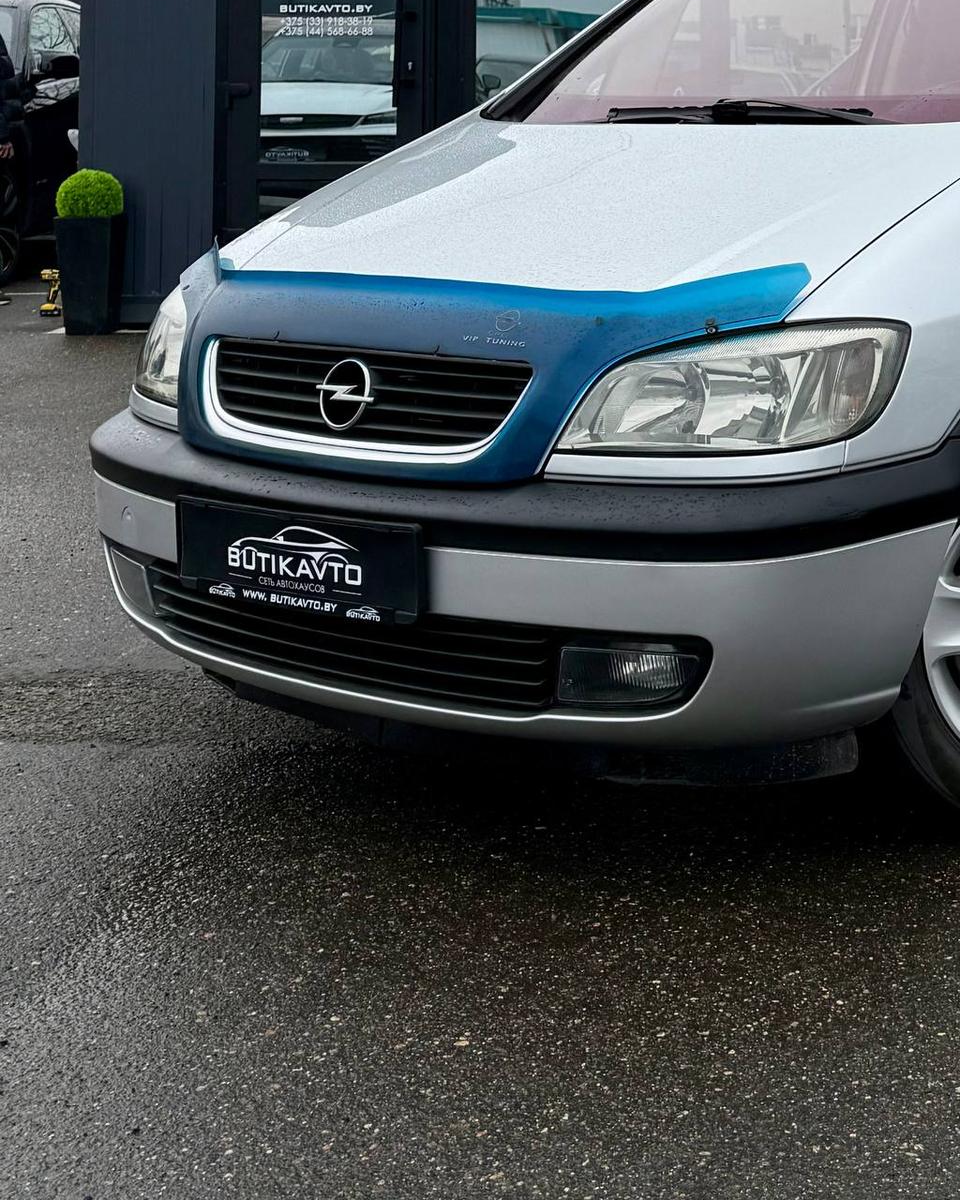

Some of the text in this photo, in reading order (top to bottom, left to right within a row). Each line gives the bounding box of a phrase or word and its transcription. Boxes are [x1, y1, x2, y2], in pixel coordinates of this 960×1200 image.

[280, 4, 373, 13] BUTIKAVTO.BY
[280, 16, 374, 27] +375 (33) 918-38-19
[305, 26, 324, 37] (44)
[326, 27, 374, 36] 568-66-88
[463, 335, 526, 347] VIP TUNING
[228, 547, 362, 586] BUTIKAVTO
[258, 575, 326, 594] СЕТЬ АВТОХАУСОВ
[242, 588, 337, 612] WWW. BUTIKAVTO.BY
